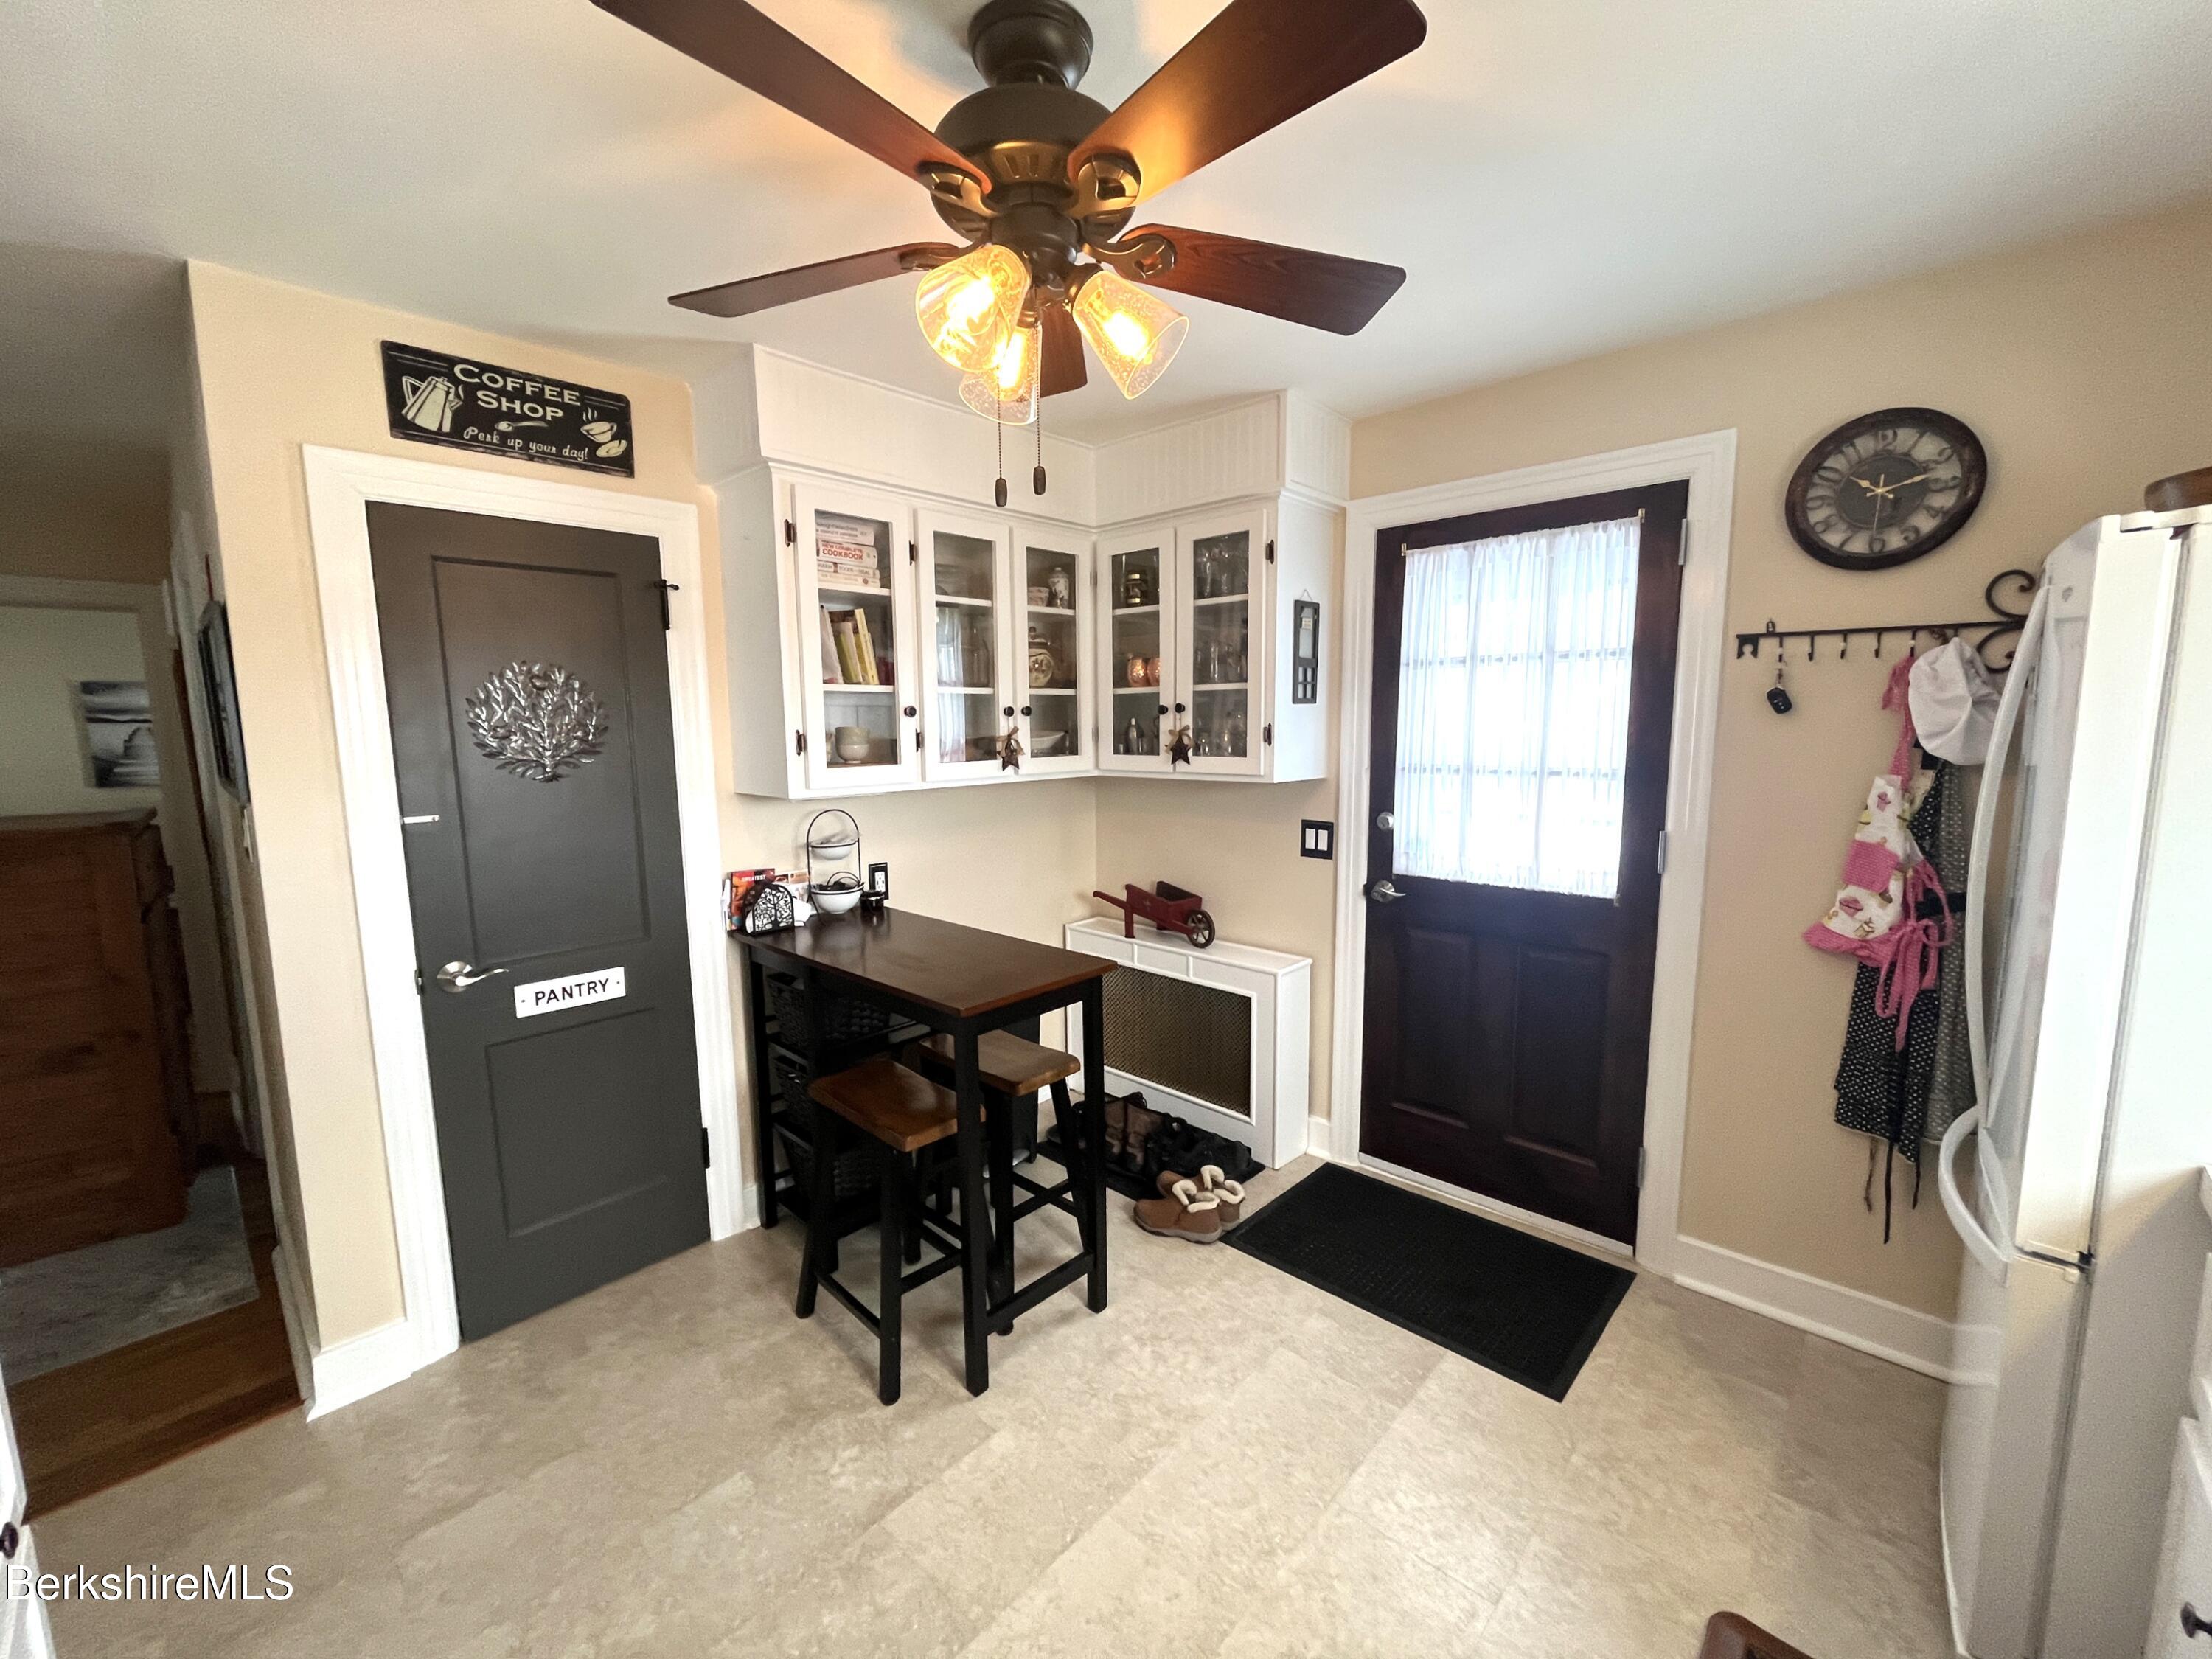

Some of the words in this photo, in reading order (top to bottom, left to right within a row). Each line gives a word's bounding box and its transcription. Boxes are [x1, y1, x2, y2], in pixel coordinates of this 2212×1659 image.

[453, 364, 581, 406] COFFEE
[476, 391, 563, 420] SHOP
[464, 426, 501, 444] Perk
[508, 439, 523, 451] up
[529, 442, 556, 454] your
[563, 445, 588, 461] day!
[822, 548, 863, 560] COOKBOOK
[535, 978, 609, 1006] PANTRY
